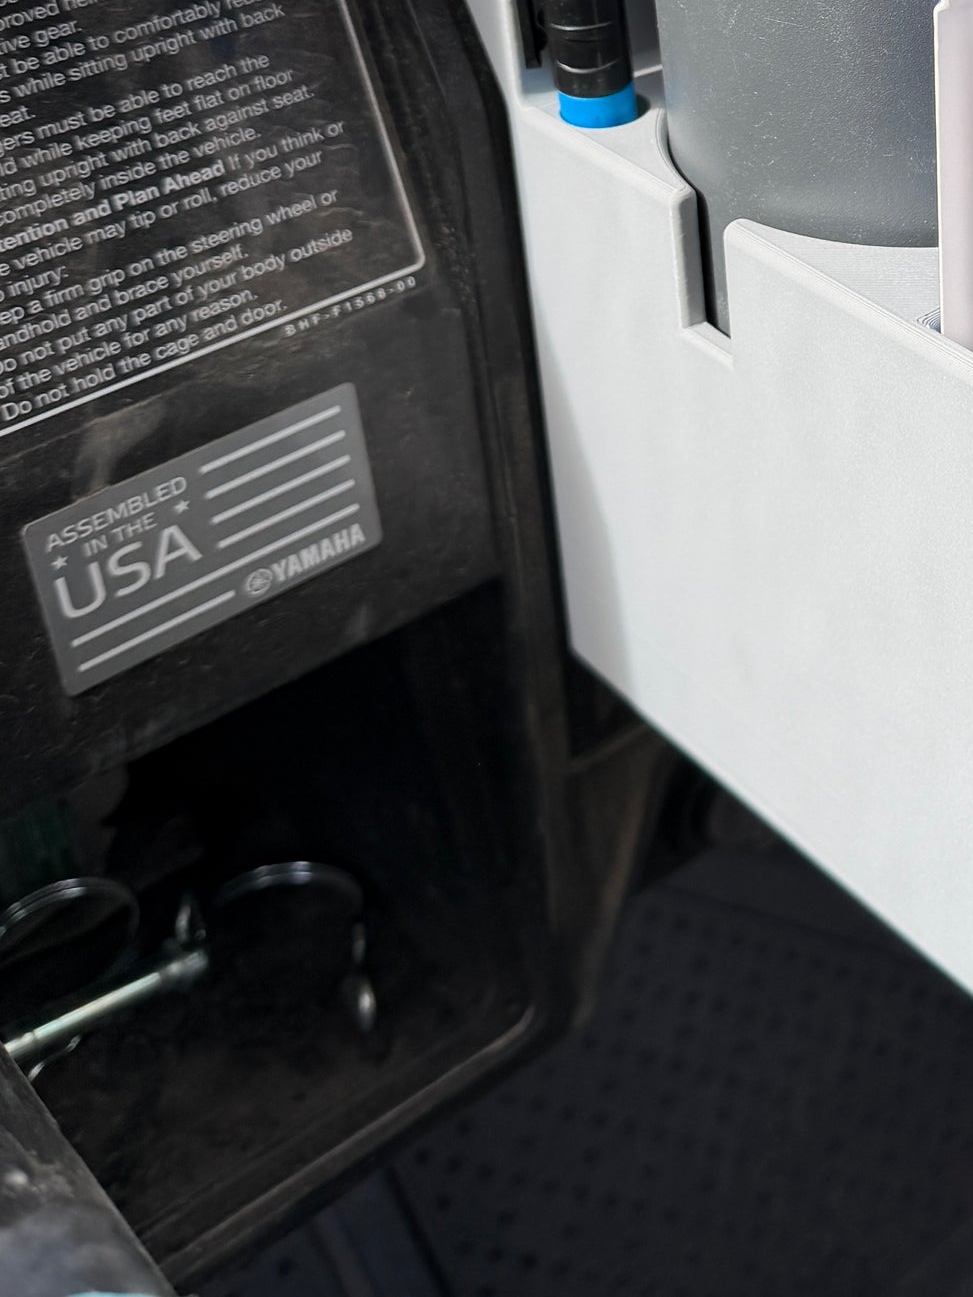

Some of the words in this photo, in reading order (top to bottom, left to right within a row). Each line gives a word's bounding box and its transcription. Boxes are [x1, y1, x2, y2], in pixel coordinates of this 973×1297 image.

[0, 90, 11, 102] s
[13, 72, 66, 98] while
[68, 53, 128, 81] sitting
[131, 30, 197, 62] upright
[199, 17, 238, 40] with
[239, 4, 285, 28] back
[11, 56, 40, 74] be
[43, 42, 86, 65] able
[88, 35, 109, 51] to
[114, 0, 221, 43] comfortably
[33, 20, 82, 47] gear.
[0, 105, 36, 127] eat.
[20, 143, 73, 168] while
[74, 117, 152, 151] keeping
[154, 102, 192, 124] feet
[195, 90, 225, 112] flat
[227, 84, 251, 101] on
[254, 69, 293, 90] floor
[36, 111, 87, 139] must
[88, 105, 116, 122] be
[120, 90, 160, 113] able
[162, 82, 183, 98] to
[186, 64, 238, 90] reach
[240, 54, 270, 74] the
[40, 152, 110, 187] upright
[111, 138, 152, 162] with
[153, 122, 201, 148] back
[204, 99, 270, 131] against
[272, 85, 315, 110] seat.
[70, 199, 112, 226] and
[113, 186, 160, 211] Plan
[162, 159, 226, 195] Ahead
[227, 154, 240, 171] If
[244, 144, 279, 170] you
[280, 127, 326, 153] think
[326, 121, 344, 138] or
[98, 162, 157, 191] inside
[158, 150, 191, 170] the
[193, 127, 262, 158] vehicle.
[0, 263, 11, 277] e
[11, 237, 84, 270] vehicle
[85, 221, 127, 243] may
[127, 211, 156, 229] tip
[159, 202, 179, 219] or
[219, 166, 282, 197] reduce
[283, 151, 322, 179] your
[0, 306, 25, 326] ep
[27, 300, 44, 314] a
[43, 284, 85, 308] firm
[86, 268, 126, 296] grip
[126, 258, 155, 277] on
[156, 245, 189, 266] the
[189, 219, 263, 254] steering
[266, 195, 318, 225] wheel
[320, 189, 338, 206] or
[0, 308, 72, 350] andhold
[72, 294, 112, 322] and
[112, 274, 169, 306] brace
[170, 243, 249, 287] yourself.
[7, 265, 69, 297] injury:
[21, 341, 55, 364] not
[57, 327, 92, 355] put
[92, 314, 128, 338] any
[130, 295, 174, 327] part
[175, 285, 195, 306] of
[197, 272, 237, 300] your
[240, 254, 287, 282] body
[286, 228, 352, 263] outside
[2, 400, 32, 421] Do
[35, 383, 70, 407] not
[70, 364, 117, 393] hold
[118, 353, 152, 374] the
[153, 333, 200, 362] cage
[203, 315, 238, 343] and
[239, 299, 288, 326] door.
[16, 368, 52, 390] the
[52, 342, 122, 375] vehicle
[123, 329, 151, 349] for
[152, 314, 188, 337] any
[189, 289, 258, 322] reason.
[46, 476, 188, 553] ASSEMBLED
[82, 535, 108, 557] IN
[112, 512, 158, 542] THE
[271, 523, 366, 582] YAMAHA
[53, 525, 204, 619] USA
